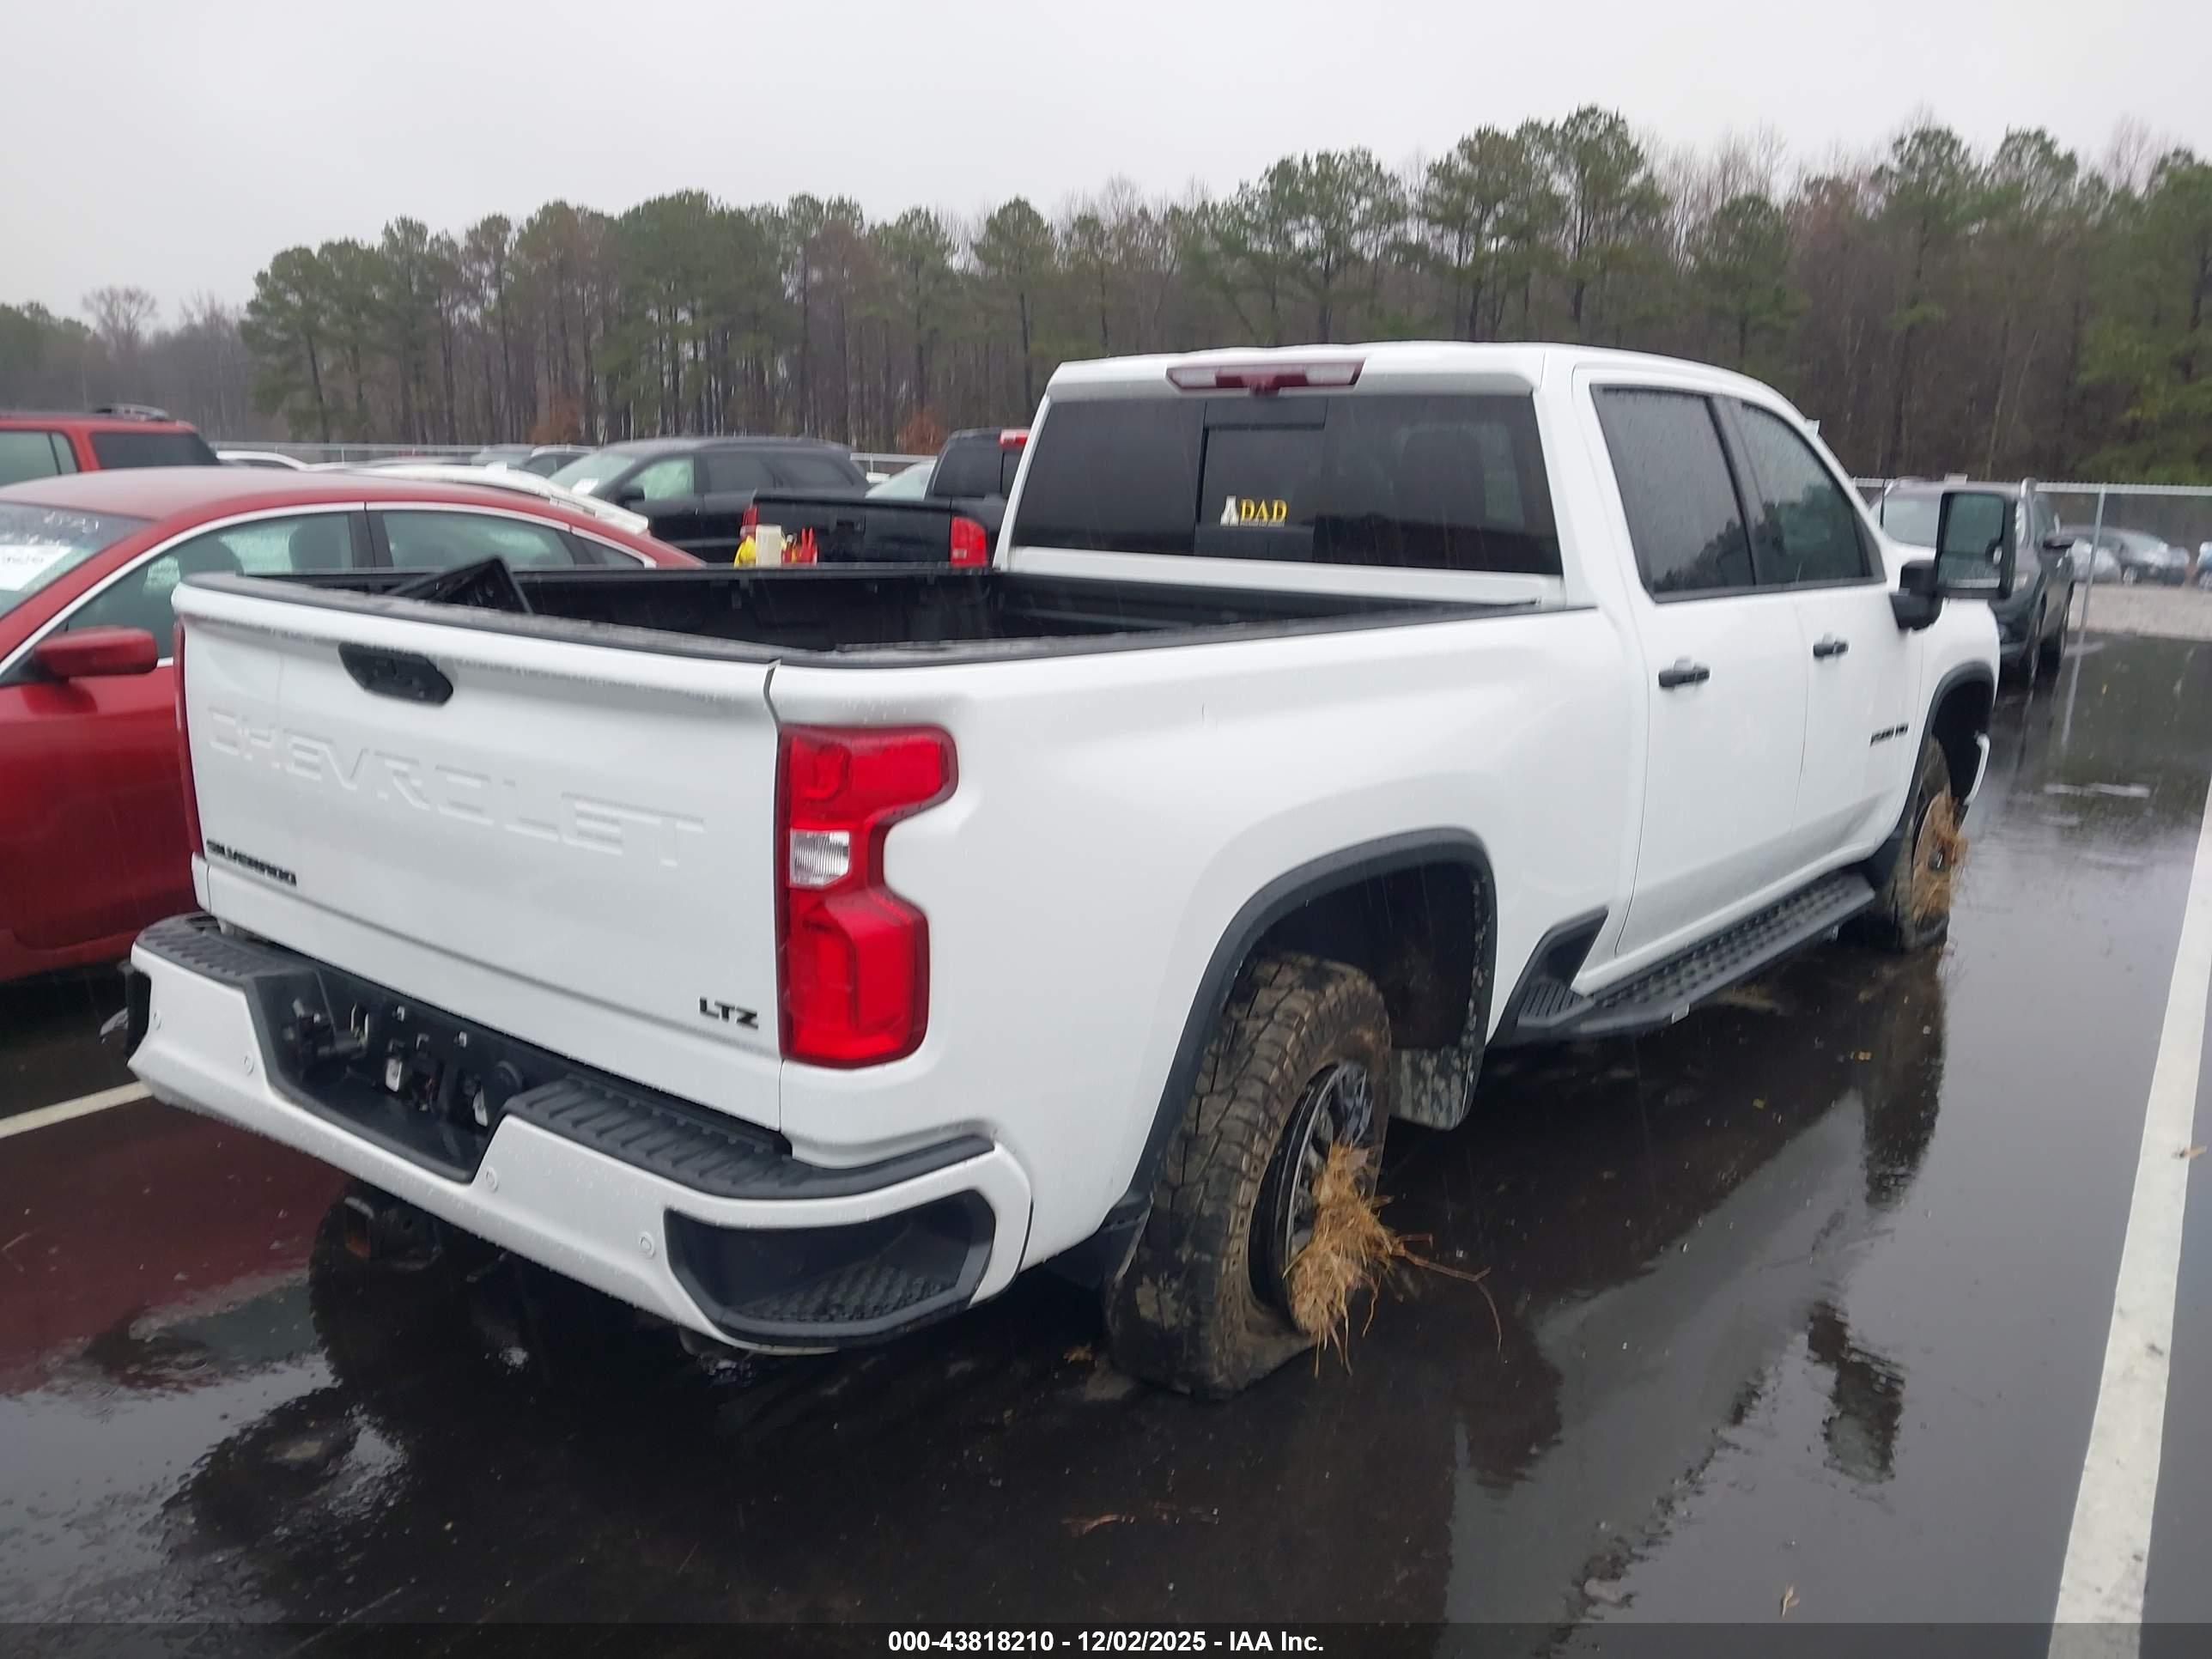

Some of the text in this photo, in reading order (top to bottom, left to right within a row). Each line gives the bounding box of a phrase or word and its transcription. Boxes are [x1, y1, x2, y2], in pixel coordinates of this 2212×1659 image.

[1240, 498, 1287, 523] DAD
[208, 706, 705, 867] CHEVROLET
[699, 997, 758, 1030] LTZ
